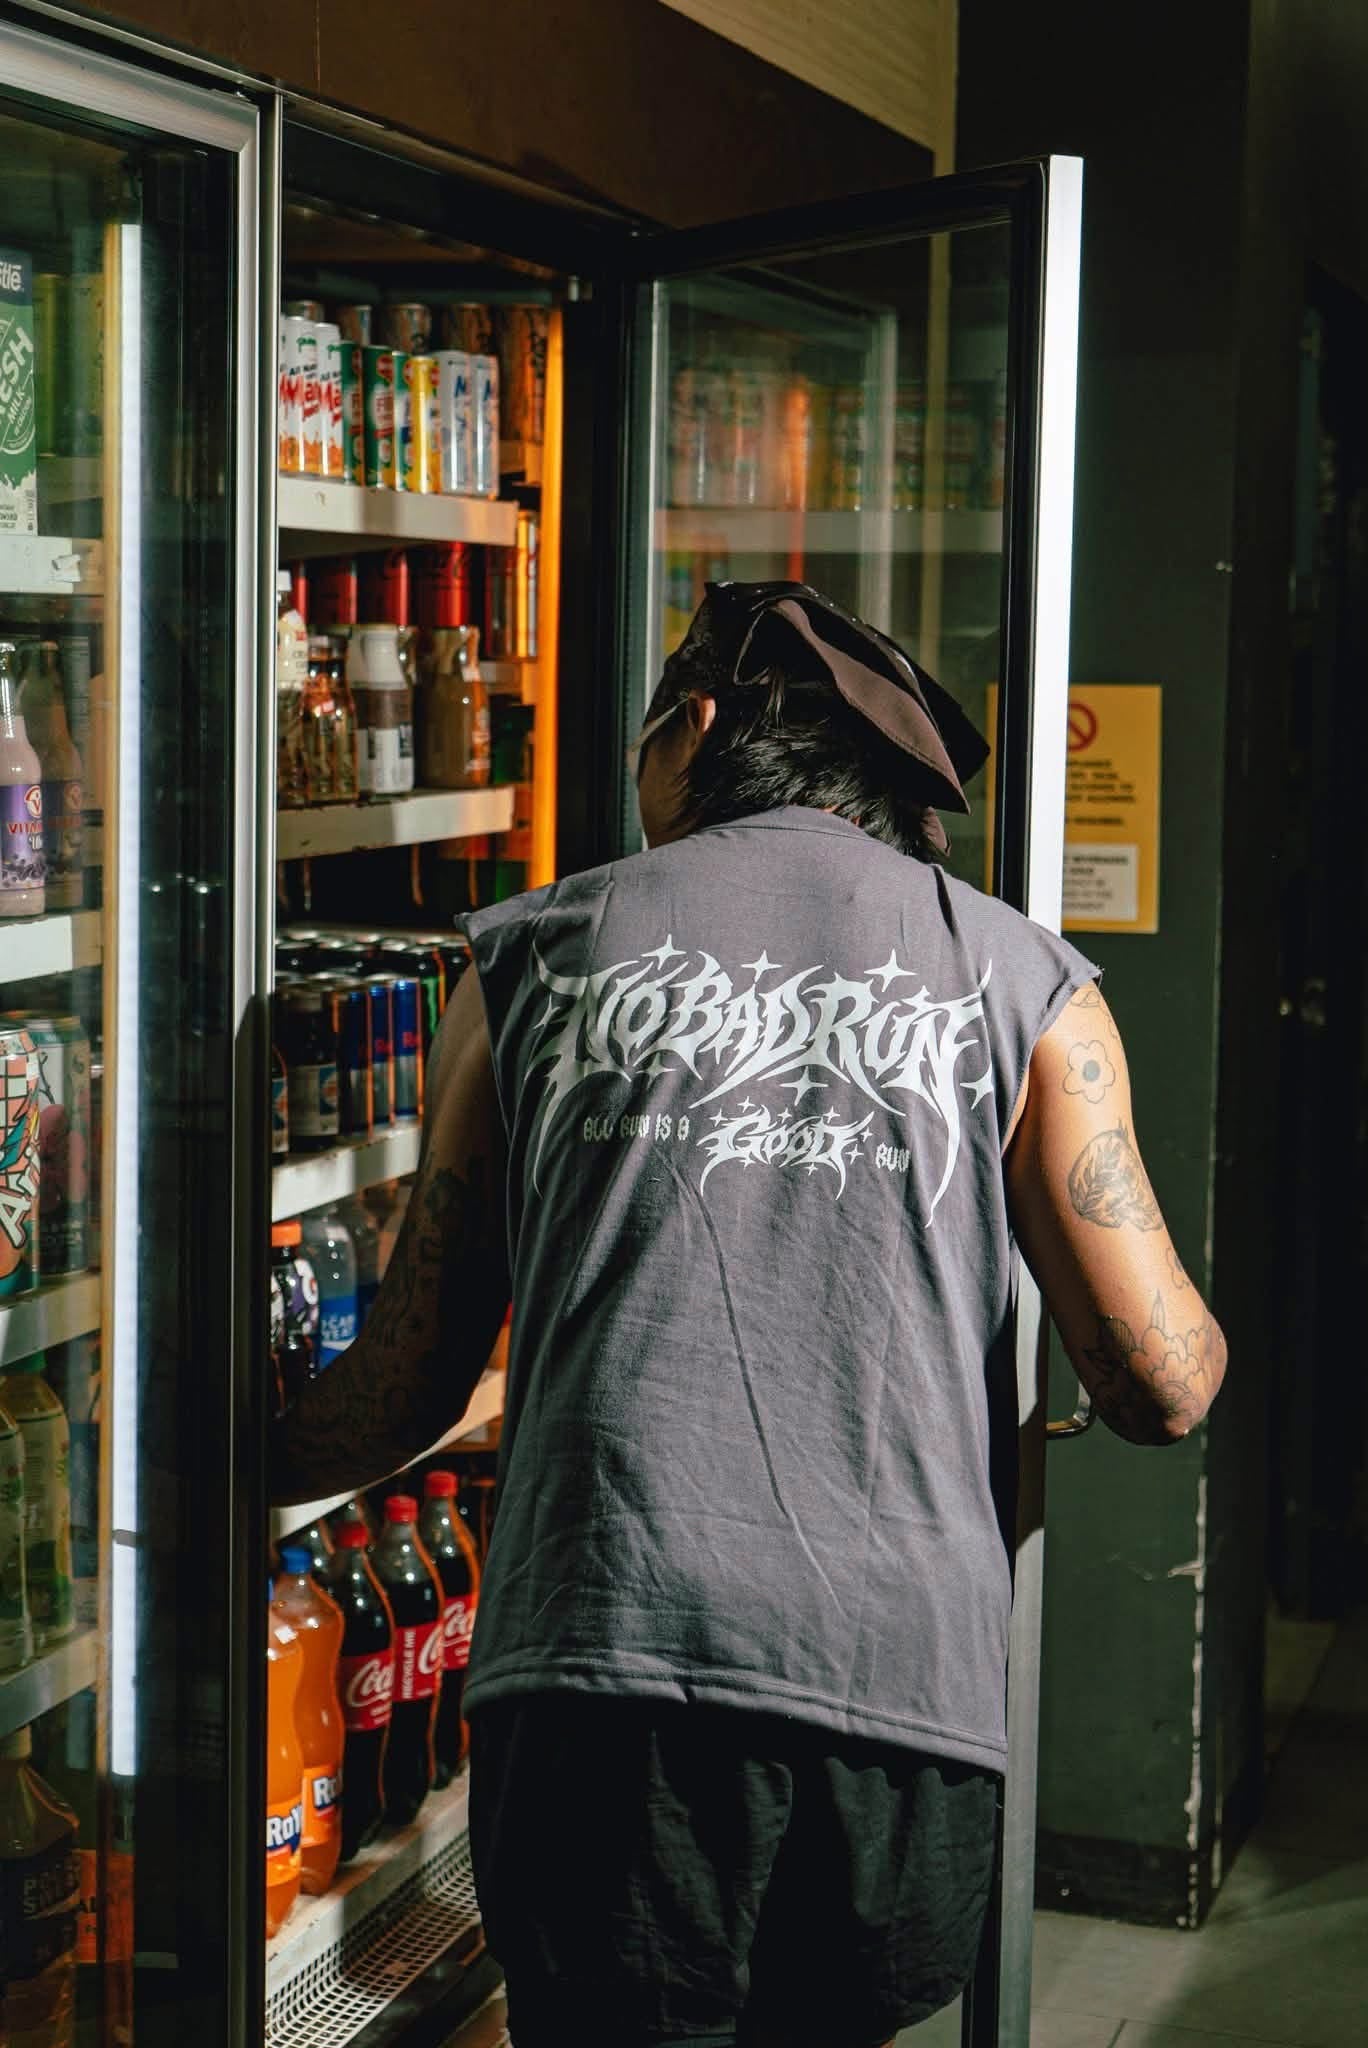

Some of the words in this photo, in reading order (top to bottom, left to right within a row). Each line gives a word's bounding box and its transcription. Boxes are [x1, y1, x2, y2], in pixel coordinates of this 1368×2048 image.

[8, 388, 25, 424] MILK
[583, 1117, 613, 1142] ALL
[620, 1114, 650, 1138] RUN
[655, 1113, 672, 1141] IS
[677, 1115, 690, 1141] A
[697, 1104, 874, 1200] GOOD
[875, 1142, 910, 1172] RUN
[401, 1650, 415, 1699] RECYCLE
